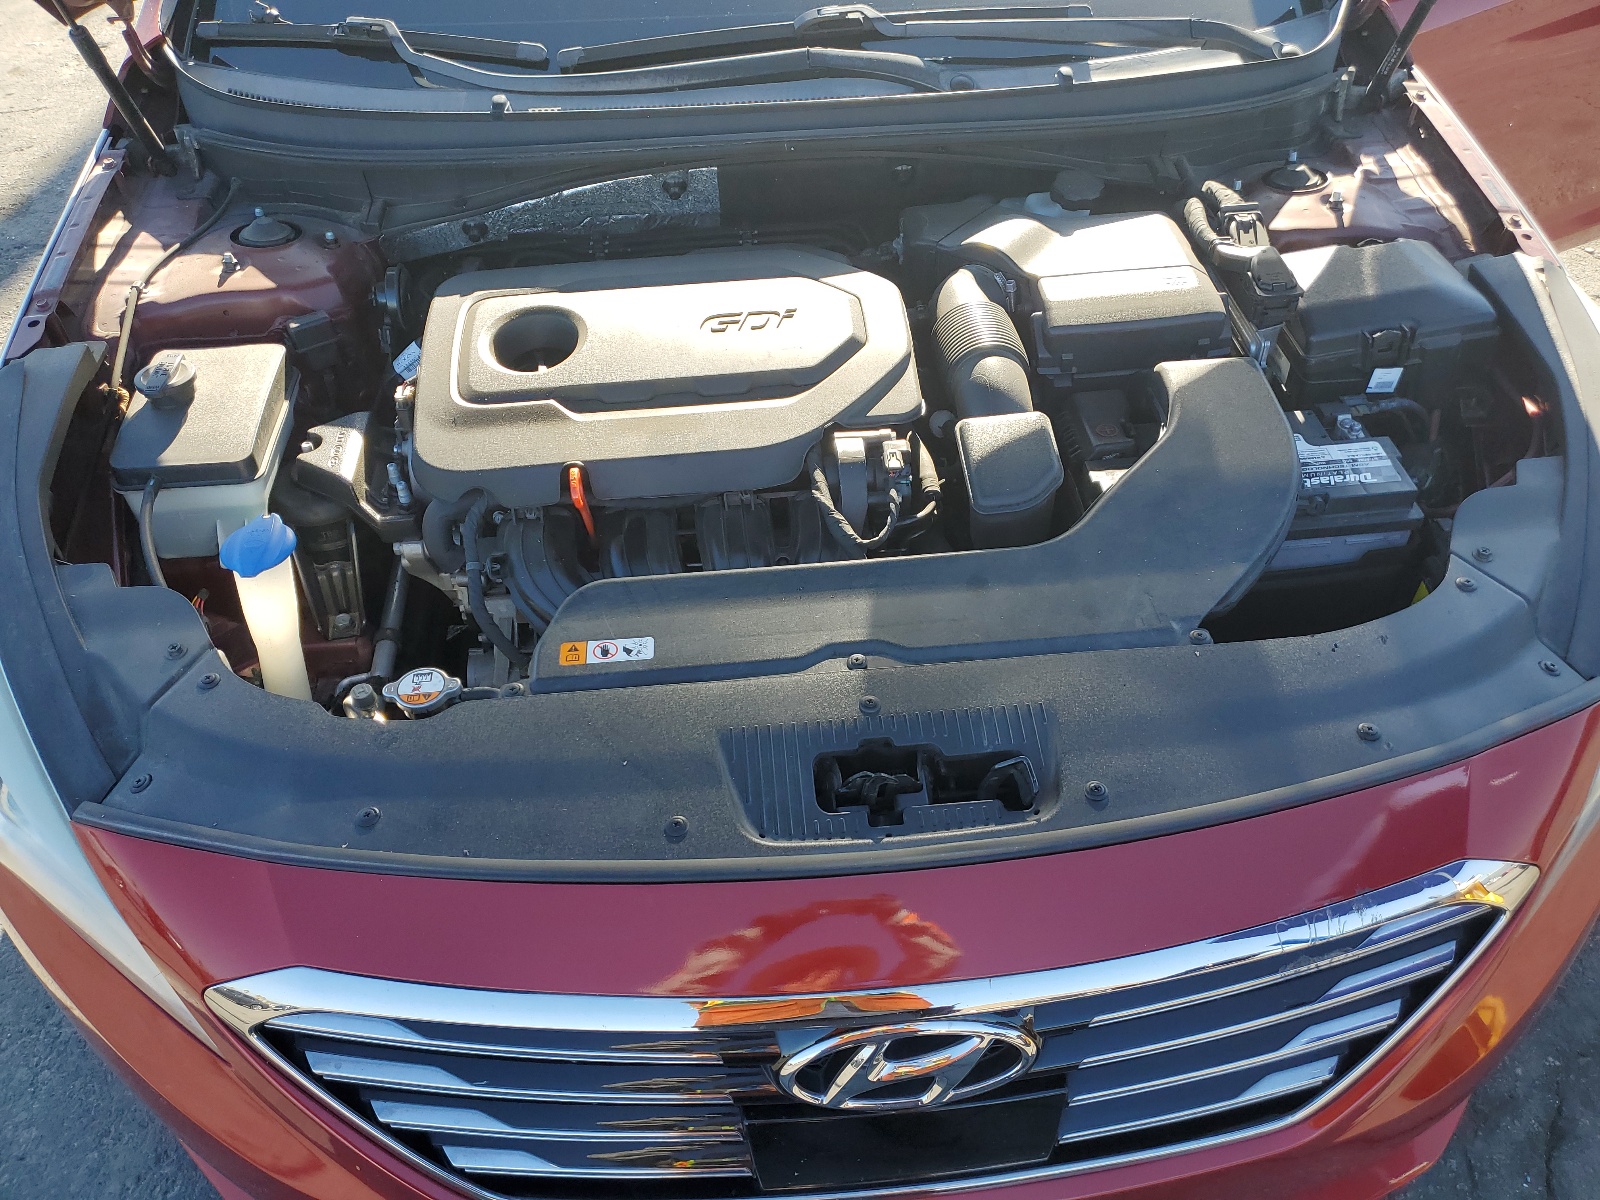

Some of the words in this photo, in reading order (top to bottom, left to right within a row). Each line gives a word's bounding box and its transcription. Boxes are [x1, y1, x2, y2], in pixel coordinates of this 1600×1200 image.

[1301, 464, 1351, 472] TECHNOLOG
[1301, 470, 1351, 478] PLATINUM
[1303, 473, 1378, 487] Duralast
